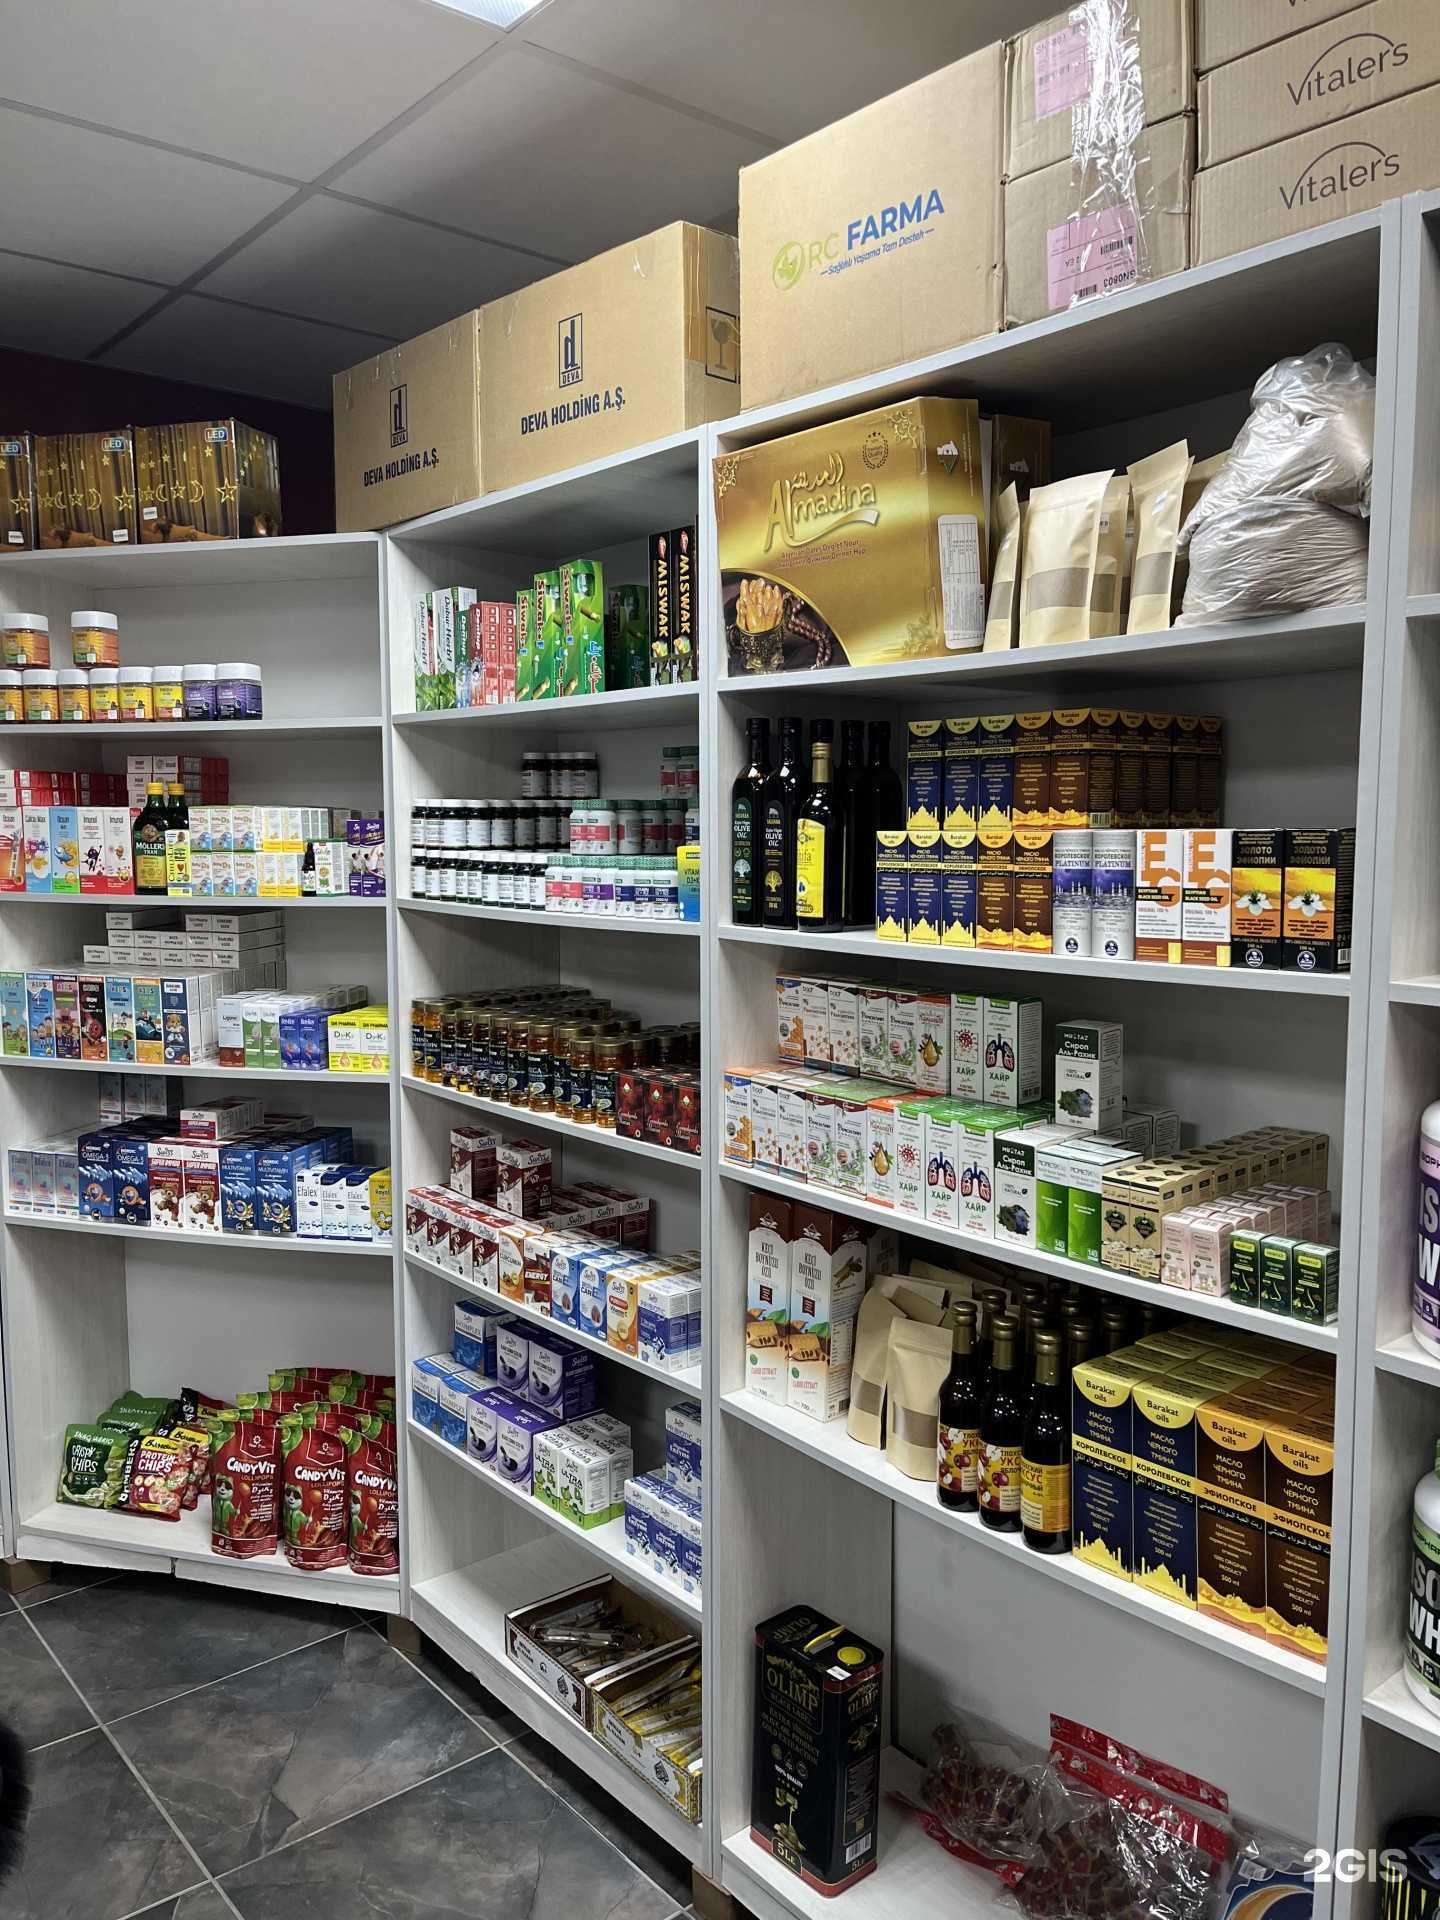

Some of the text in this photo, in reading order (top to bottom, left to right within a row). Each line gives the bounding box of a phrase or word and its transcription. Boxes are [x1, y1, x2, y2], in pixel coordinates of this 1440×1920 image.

[1287, 40, 1408, 105] Vitalers
[1280, 150, 1400, 210] Vitalers
[847, 188, 945, 251] FARMA
[562, 371, 580, 384] DEVA
[521, 414, 549, 435] DEVA
[552, 394, 600, 426] HOLDİNG
[207, 430, 225, 440] LED
[105, 439, 122, 449] LED
[363, 466, 384, 488] DEVA
[385, 452, 420, 479] HOLDİNG
[764, 478, 876, 554] Almadina
[657, 559, 669, 638] MISWAK
[679, 554, 691, 635] MISWAK
[733, 824, 751, 833] OLIVE
[765, 832, 783, 841] OLIVE
[1294, 846, 1327, 854] ЗОЛОТО
[1055, 860, 1090, 869] PLATINUM
[1094, 860, 1131, 869] PLATINUM
[1064, 1040, 1089, 1051] Сироп
[1058, 1049, 1097, 1059] Аль-Рахик
[956, 1066, 977, 1077] ХАЙР
[989, 1071, 1010, 1082] ХАЙР
[1002, 1155, 1026, 1167] Сироп
[996, 1161, 1033, 1177] Аль-Рахик
[297, 1186, 317, 1198] Efalex
[931, 1190, 952, 1201] ХАЙР
[965, 1201, 987, 1213] ХАЙР
[1086, 1379, 1116, 1396] Barakat
[1094, 1394, 1107, 1403] oils
[1147, 1399, 1180, 1417] Barakat
[1089, 1410, 1112, 1424] МАСЛО
[1155, 1414, 1170, 1423] oils
[1211, 1421, 1248, 1440] Barakat
[1150, 1431, 1176, 1445] МАСЛО
[1222, 1436, 1237, 1446] oils
[1076, 1440, 1127, 1465] КОРОЛЕВСКОЕ
[1150, 1451, 1175, 1466] ТМИНА
[1282, 1443, 1320, 1463] Barakat
[71, 1456, 98, 1473] CHIPS
[138, 1459, 173, 1473] CHIPS
[1000, 1456, 1020, 1466] УКС
[1215, 1453, 1243, 1469] МАСЛО
[1292, 1460, 1309, 1470] oils
[1000, 1466, 1021, 1474] ЯБЛОЧ
[1136, 1461, 1192, 1488] КОРОЛЕВСКОЕ
[354, 1469, 397, 1491] CANDYVI
[1216, 1474, 1244, 1490] ТМИНА
[1286, 1478, 1316, 1495] МАСЛО
[1203, 1487, 1257, 1512] ЭФИОПСКОЕ
[1287, 1500, 1315, 1516] ТМИНА
[1272, 1513, 1331, 1540] ЭФИОПСКОЕ
[1291, 1603, 1303, 1613] 500
[1408, 1591, 1440, 1656] WH
[766, 1666, 819, 1713] OLIMP
